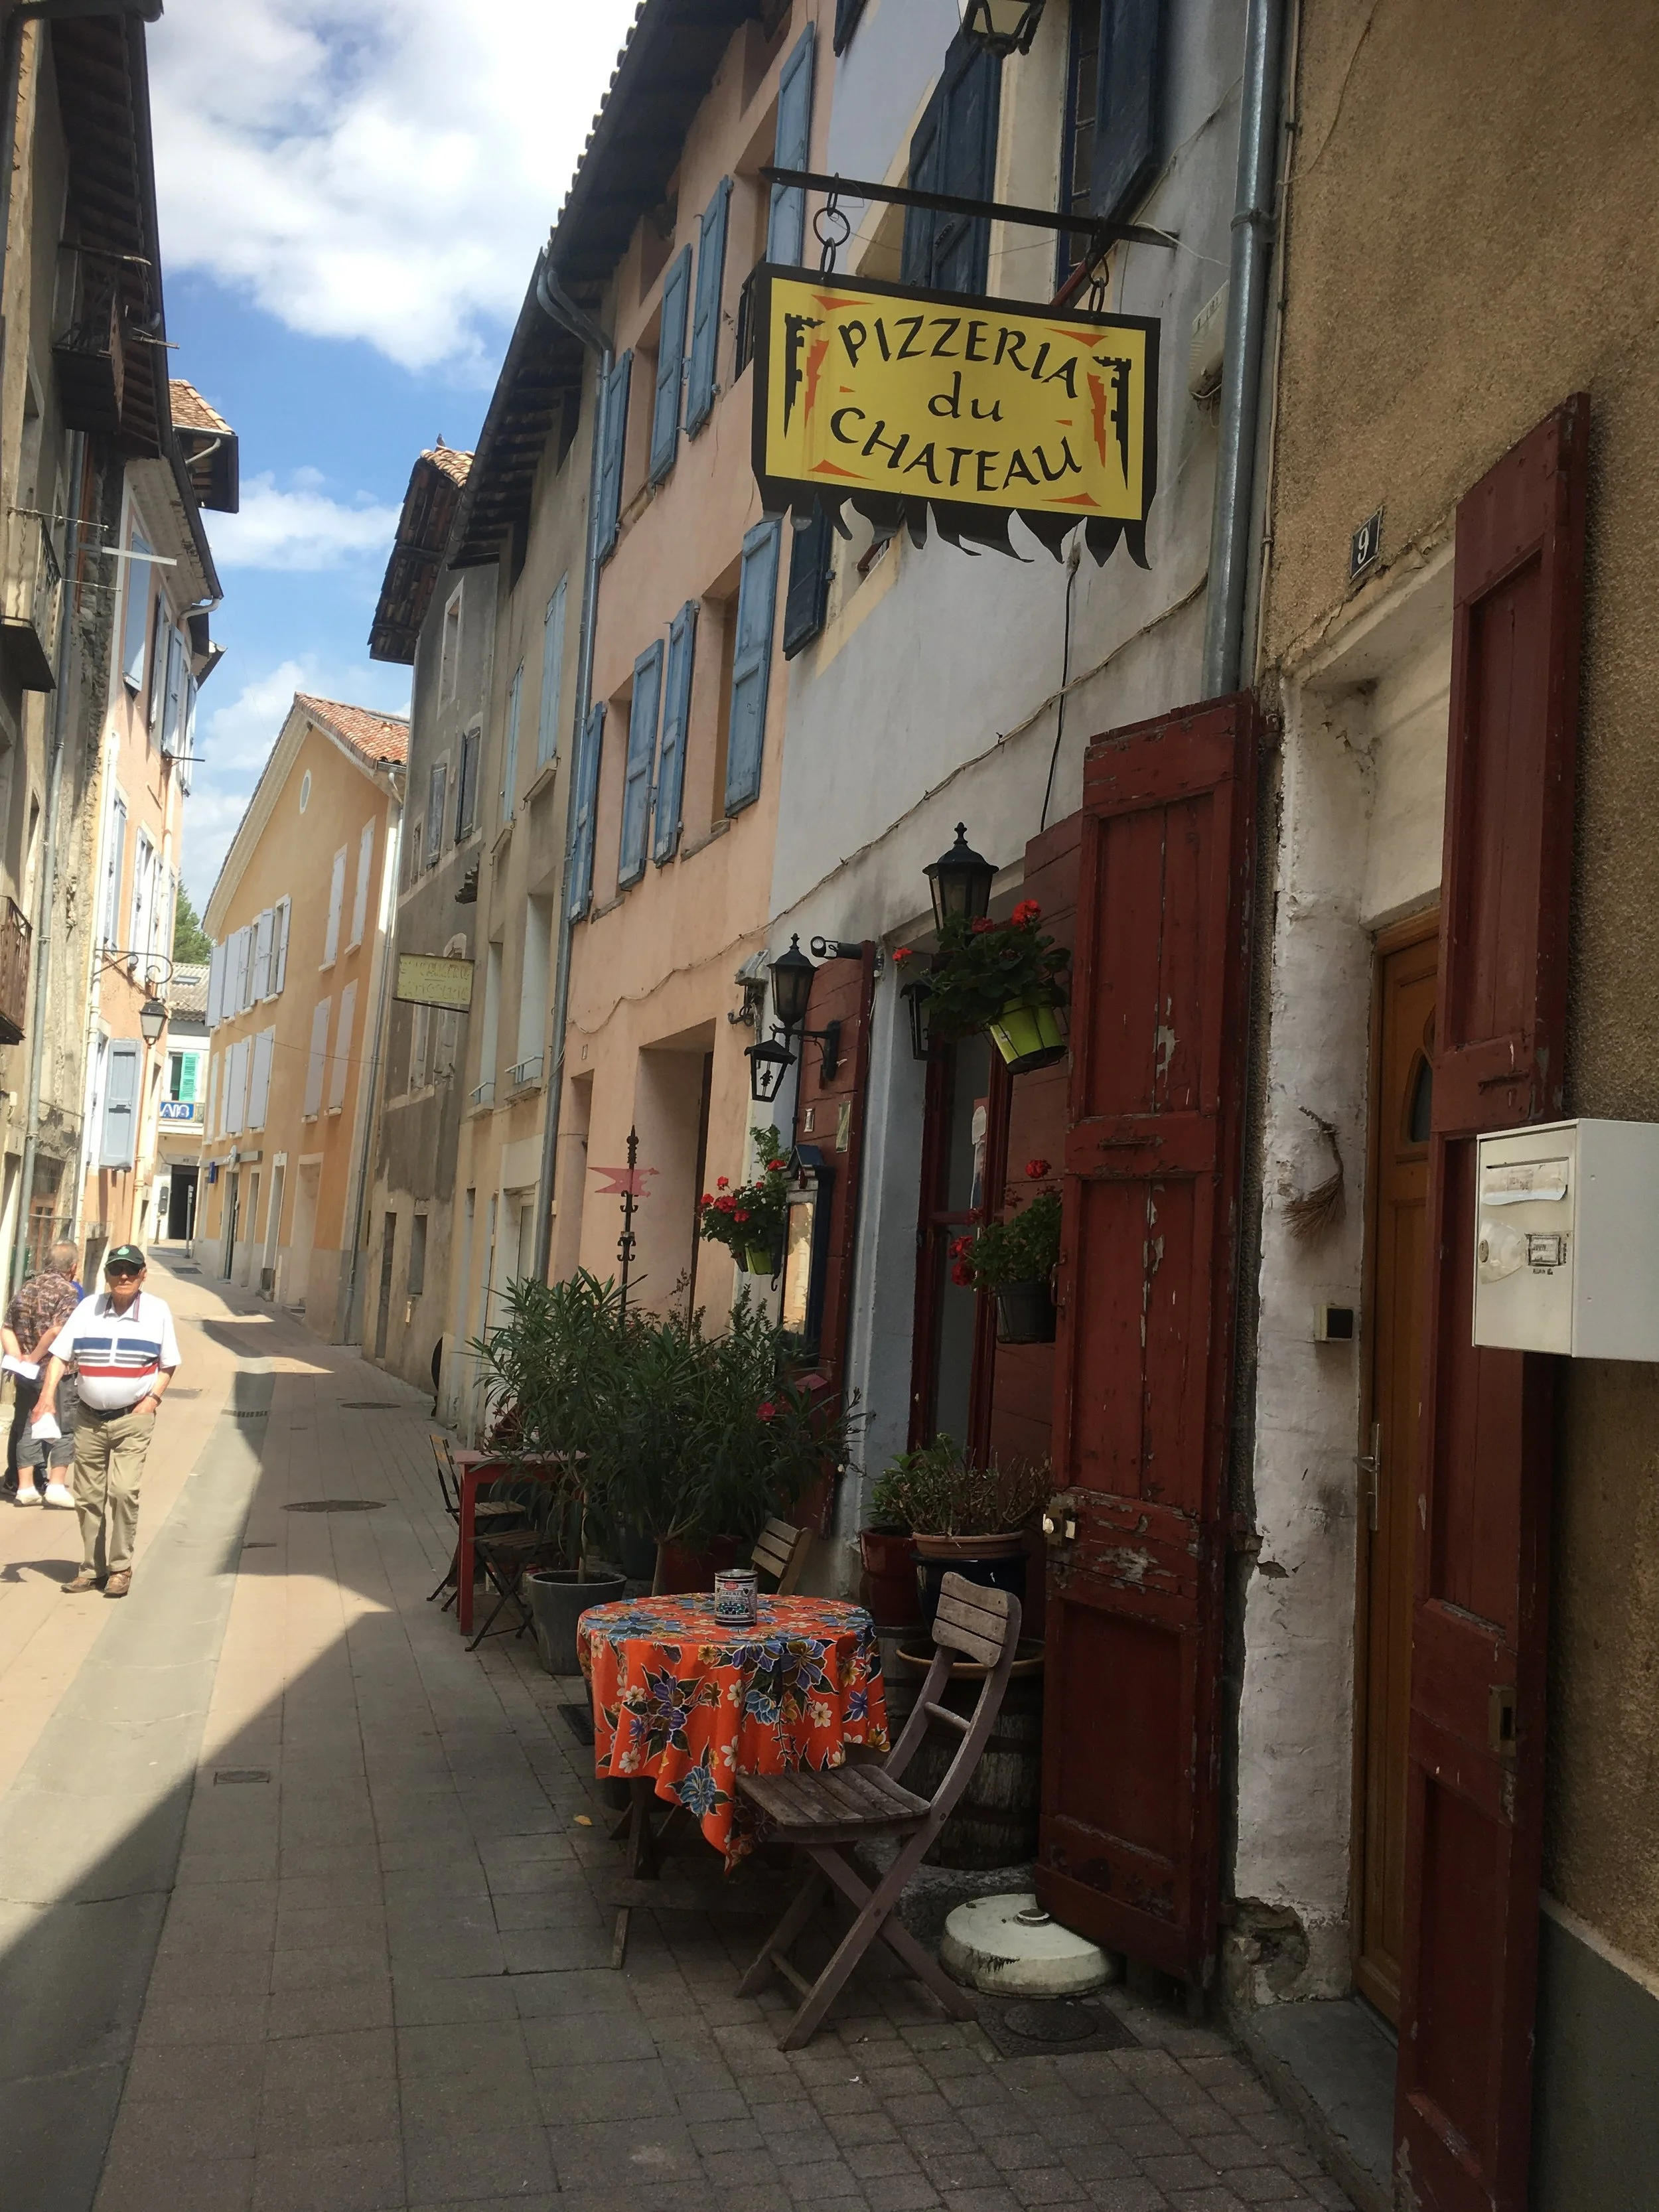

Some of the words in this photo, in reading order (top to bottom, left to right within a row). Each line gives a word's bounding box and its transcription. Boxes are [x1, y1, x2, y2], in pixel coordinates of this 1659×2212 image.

[837, 315, 1078, 399] PIZZERIA
[928, 371, 1003, 422] du
[830, 406, 1082, 492] CHATEAU
[1357, 527, 1370, 564] 9
